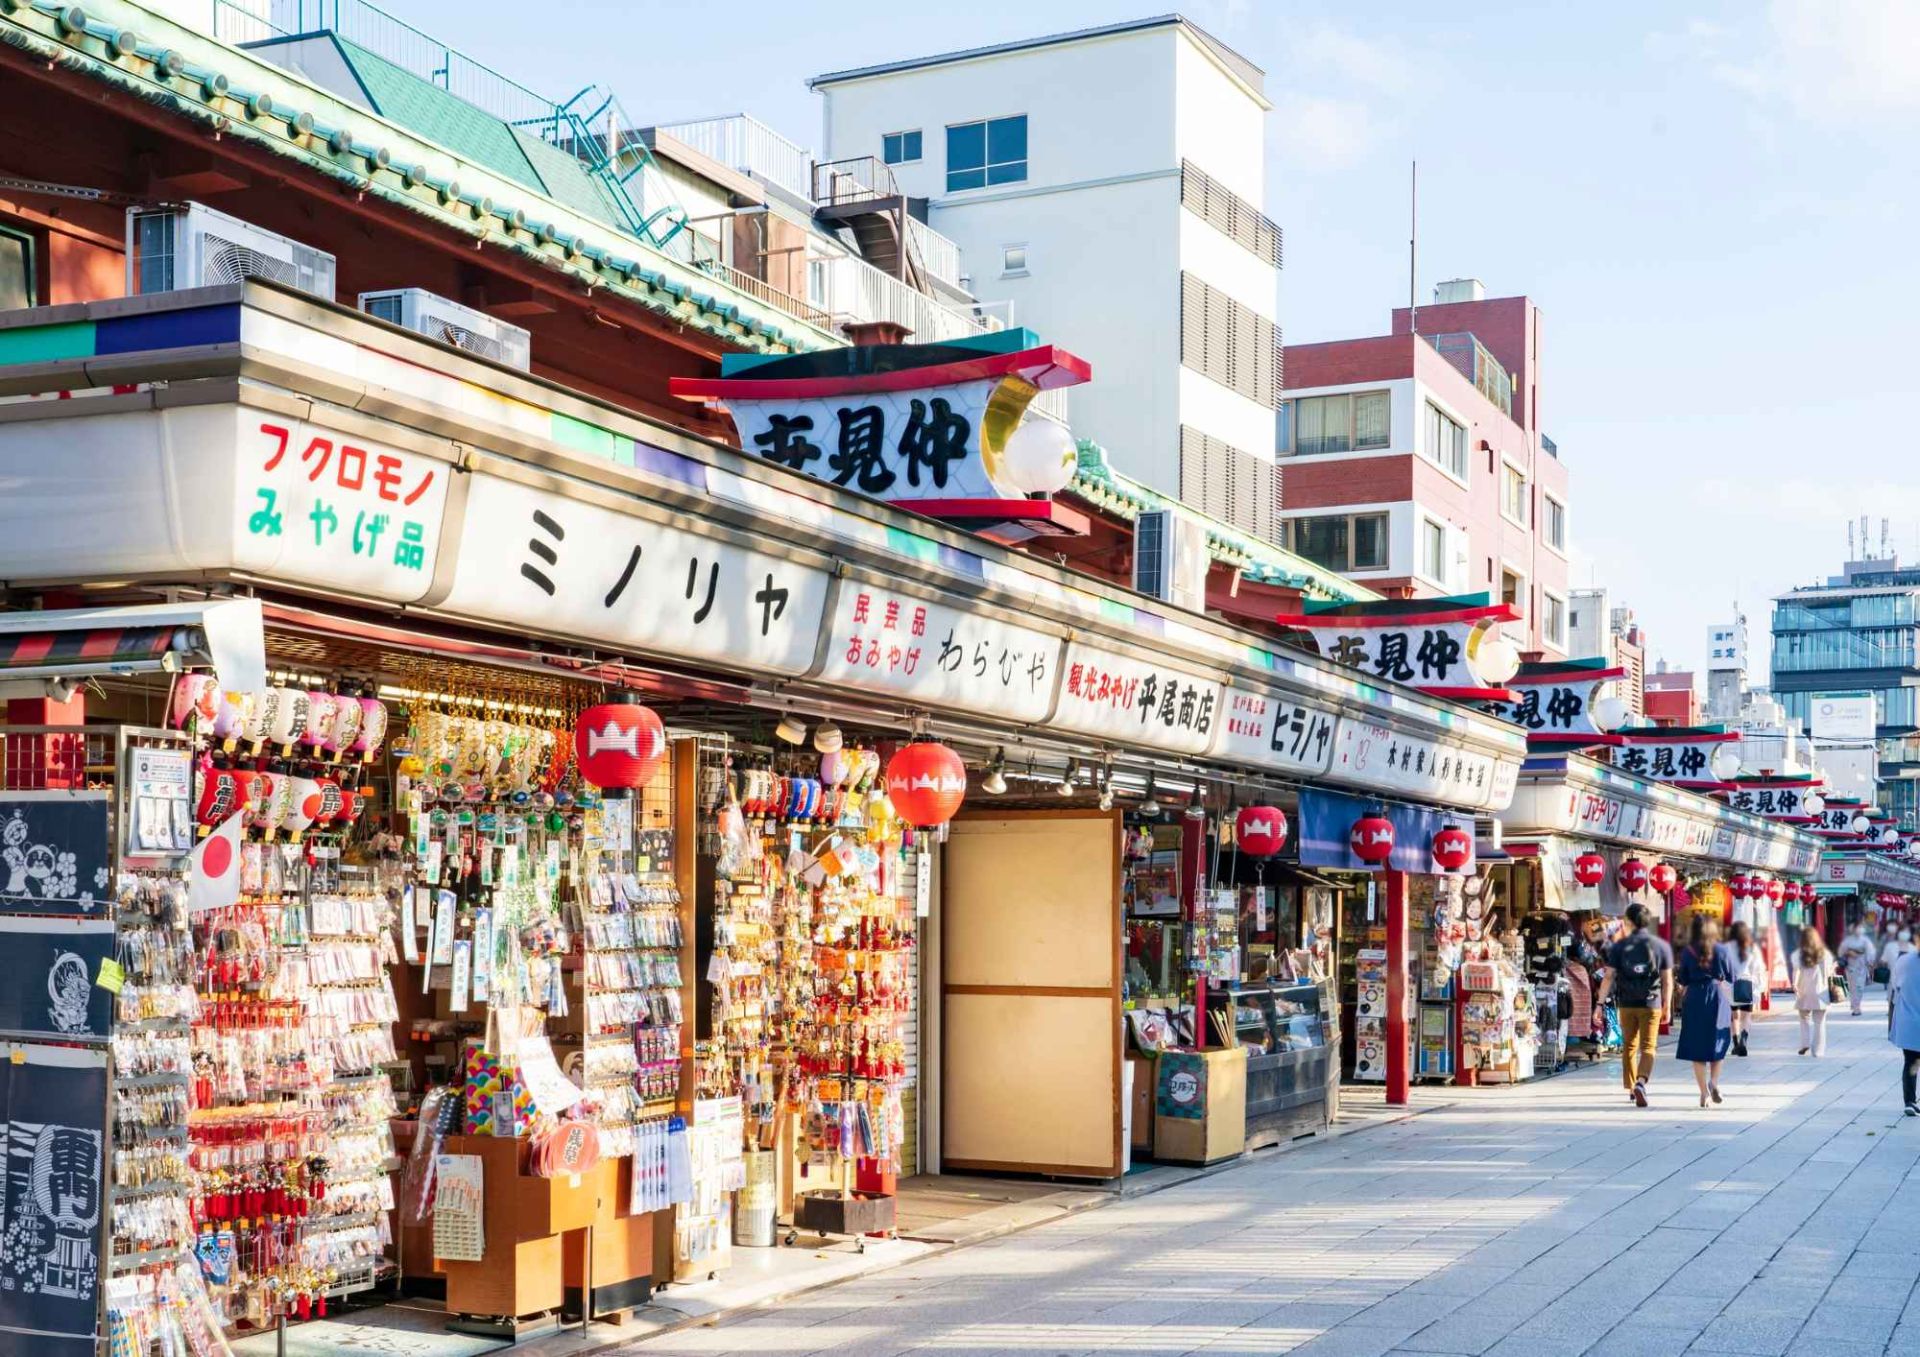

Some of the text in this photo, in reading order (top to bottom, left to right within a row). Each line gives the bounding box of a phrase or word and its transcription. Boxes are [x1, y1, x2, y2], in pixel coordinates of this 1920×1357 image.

[259, 423, 434, 506] フクロモノ
[249, 488, 424, 572] みやげ品
[521, 509, 789, 636] ミノリヤ
[853, 593, 927, 637] 民芸品
[845, 634, 921, 676] おみやげ
[937, 628, 1046, 695] わらびや
[1067, 662, 1139, 710] 観光みやげ
[1138, 673, 1214, 735] 平尾商店
[1271, 702, 1330, 762] ヒラノヤ
